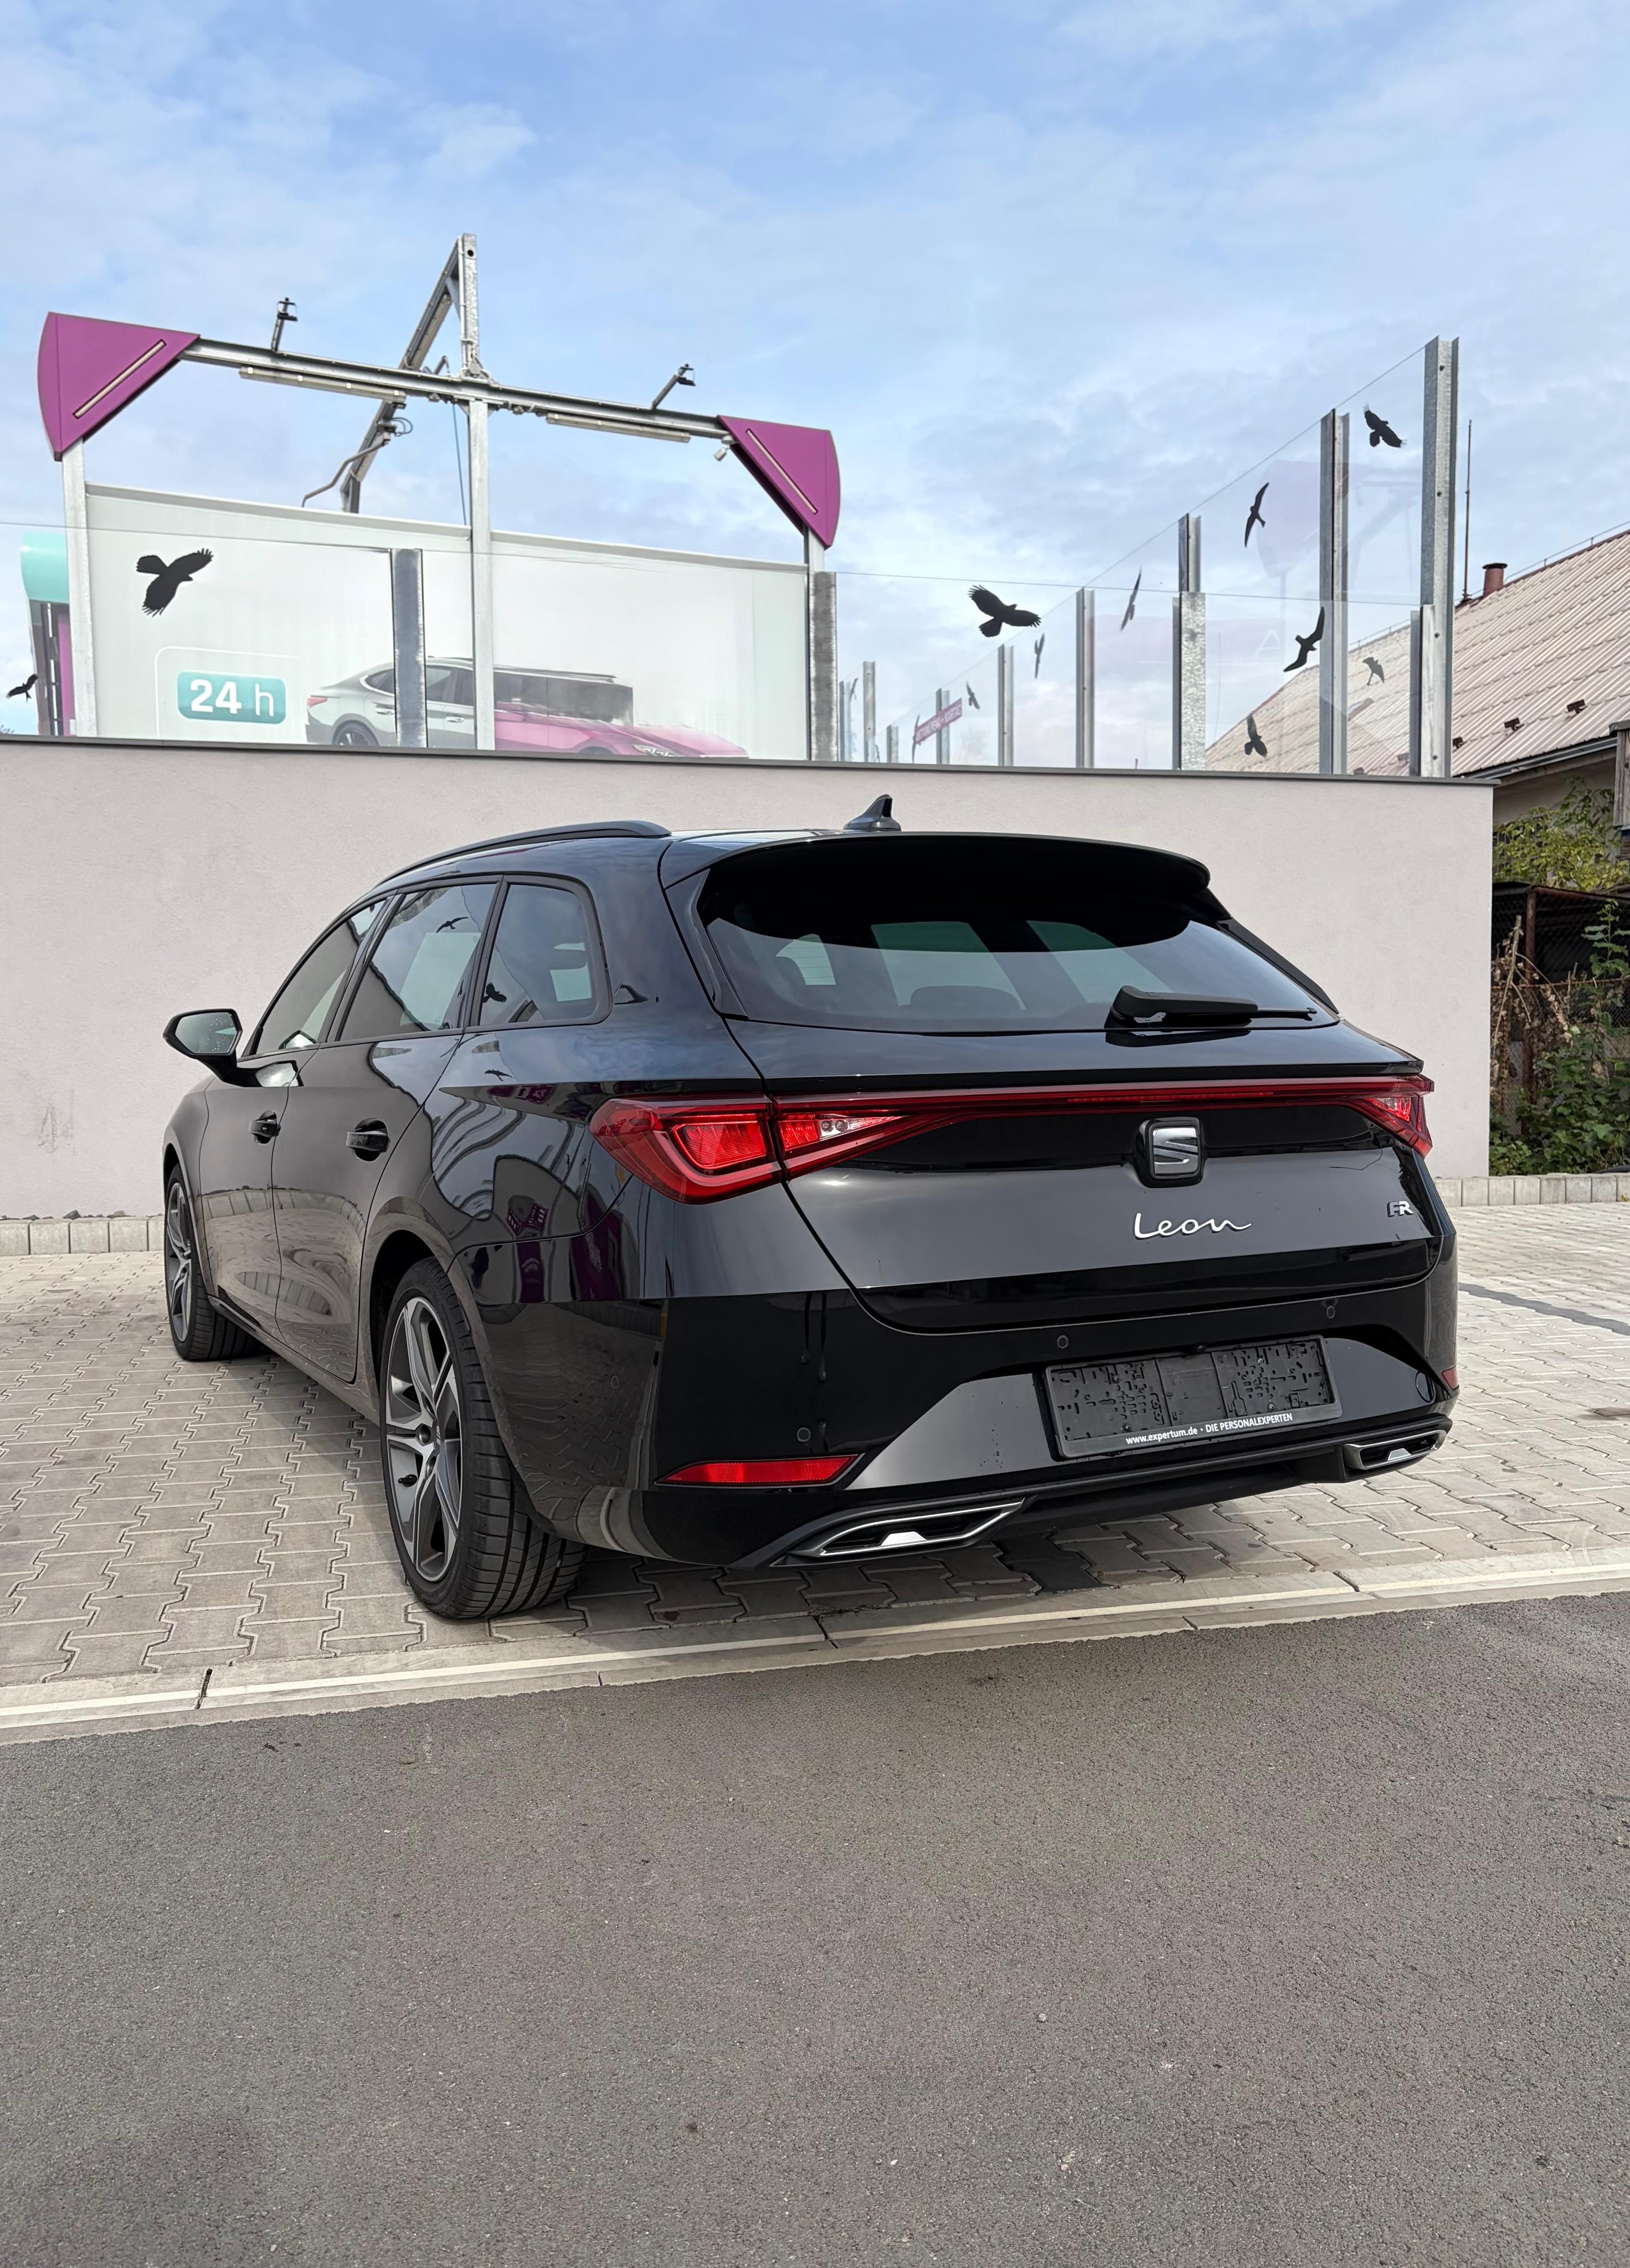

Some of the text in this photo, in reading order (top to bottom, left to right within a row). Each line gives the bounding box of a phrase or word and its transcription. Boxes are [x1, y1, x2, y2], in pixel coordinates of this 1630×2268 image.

[190, 679, 275, 717] 24 h
[1387, 1200, 1414, 1217] FR
[1134, 1213, 1252, 1239] Leon
[1125, 1413, 1293, 1445] www.expertum.de DIE PERSONALEXPERTEN
